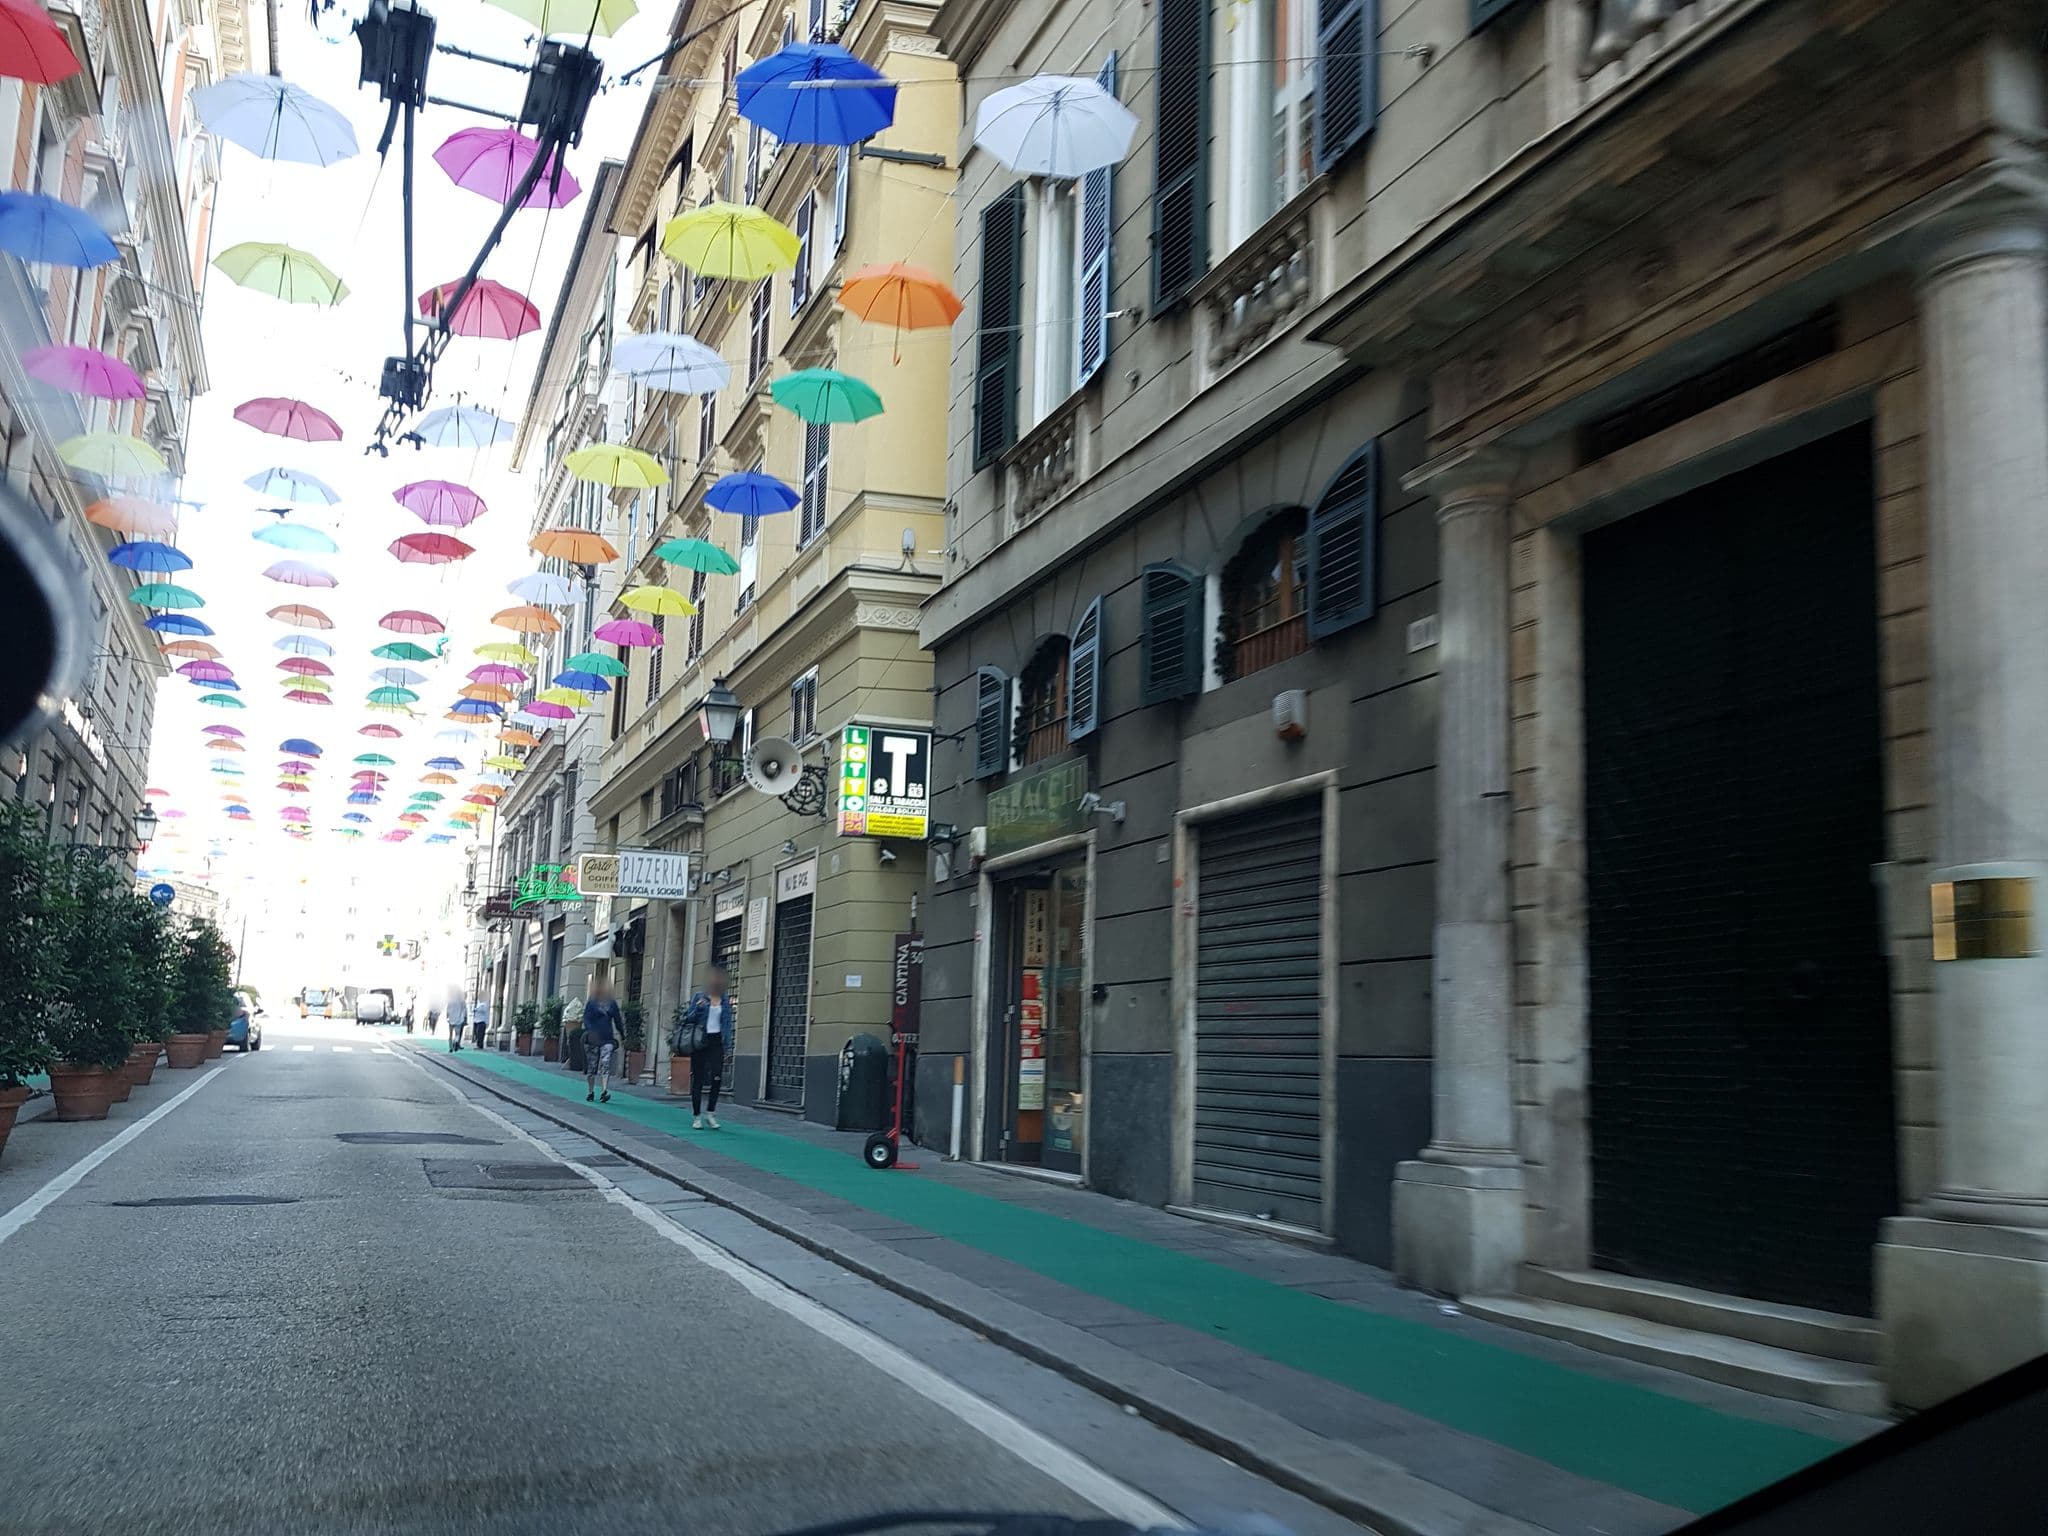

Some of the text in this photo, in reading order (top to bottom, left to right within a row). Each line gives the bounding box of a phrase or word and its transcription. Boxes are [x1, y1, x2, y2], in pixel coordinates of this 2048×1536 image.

[845, 729, 865, 811] LOTTO
[883, 736, 917, 797] T
[622, 856, 684, 886] PIZZERIA
[562, 902, 582, 911] BAR
[896, 943, 910, 1006] CANTINA
